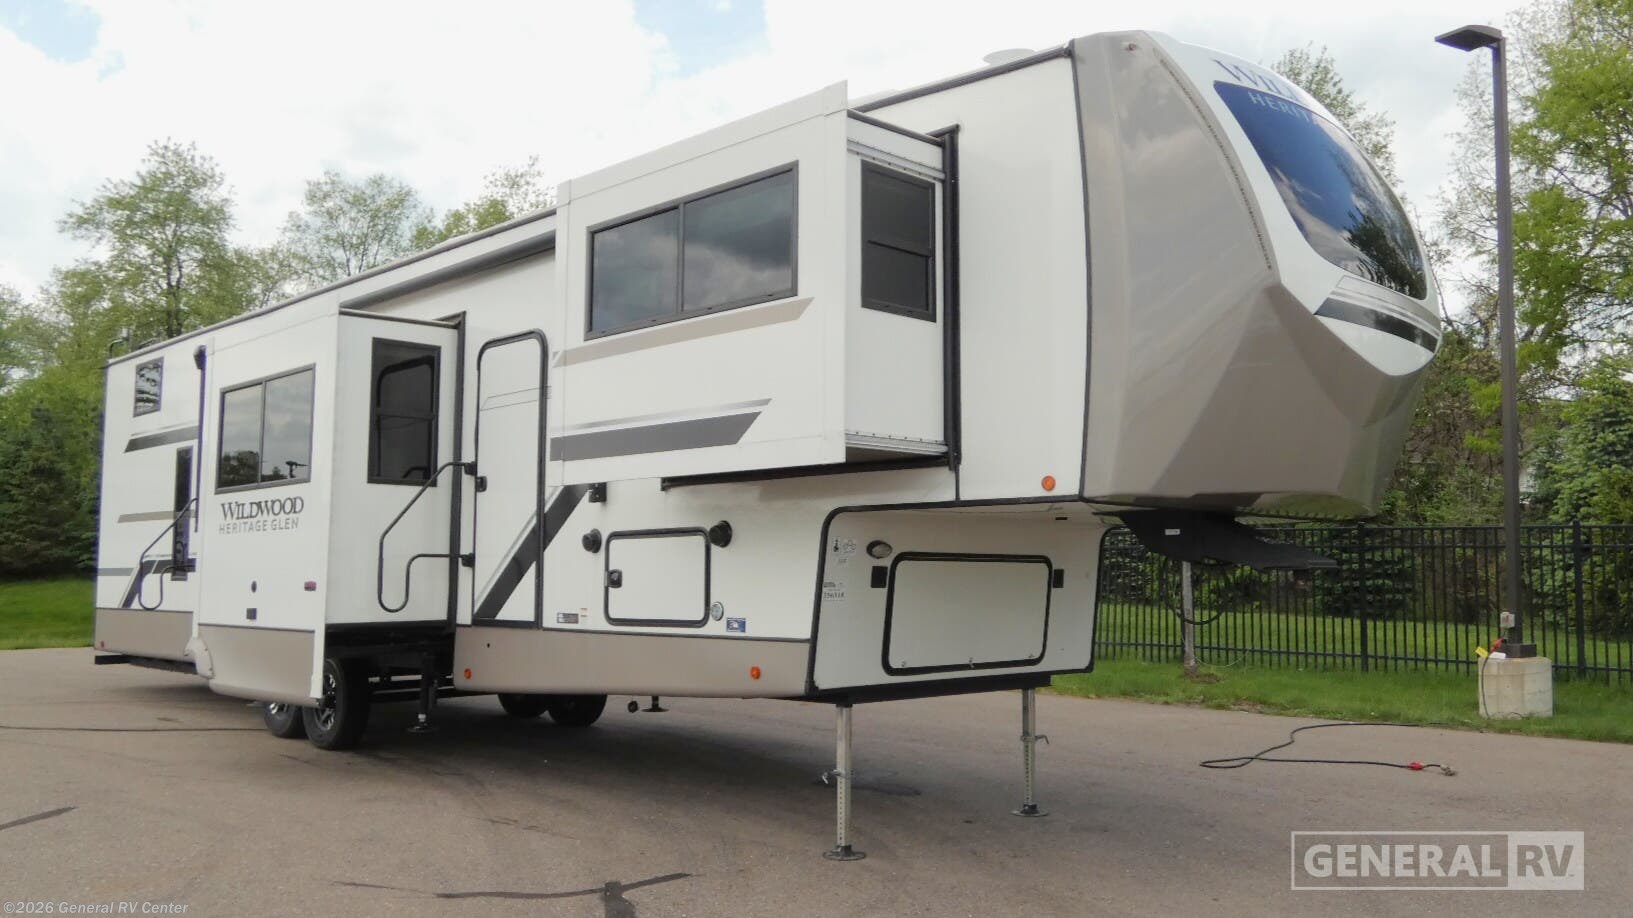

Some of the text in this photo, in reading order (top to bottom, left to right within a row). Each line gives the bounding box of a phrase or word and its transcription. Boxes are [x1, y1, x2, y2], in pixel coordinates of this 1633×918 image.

[220, 496, 304, 520] WILDWOOD
[219, 517, 299, 534] HERITAGE GLEN
